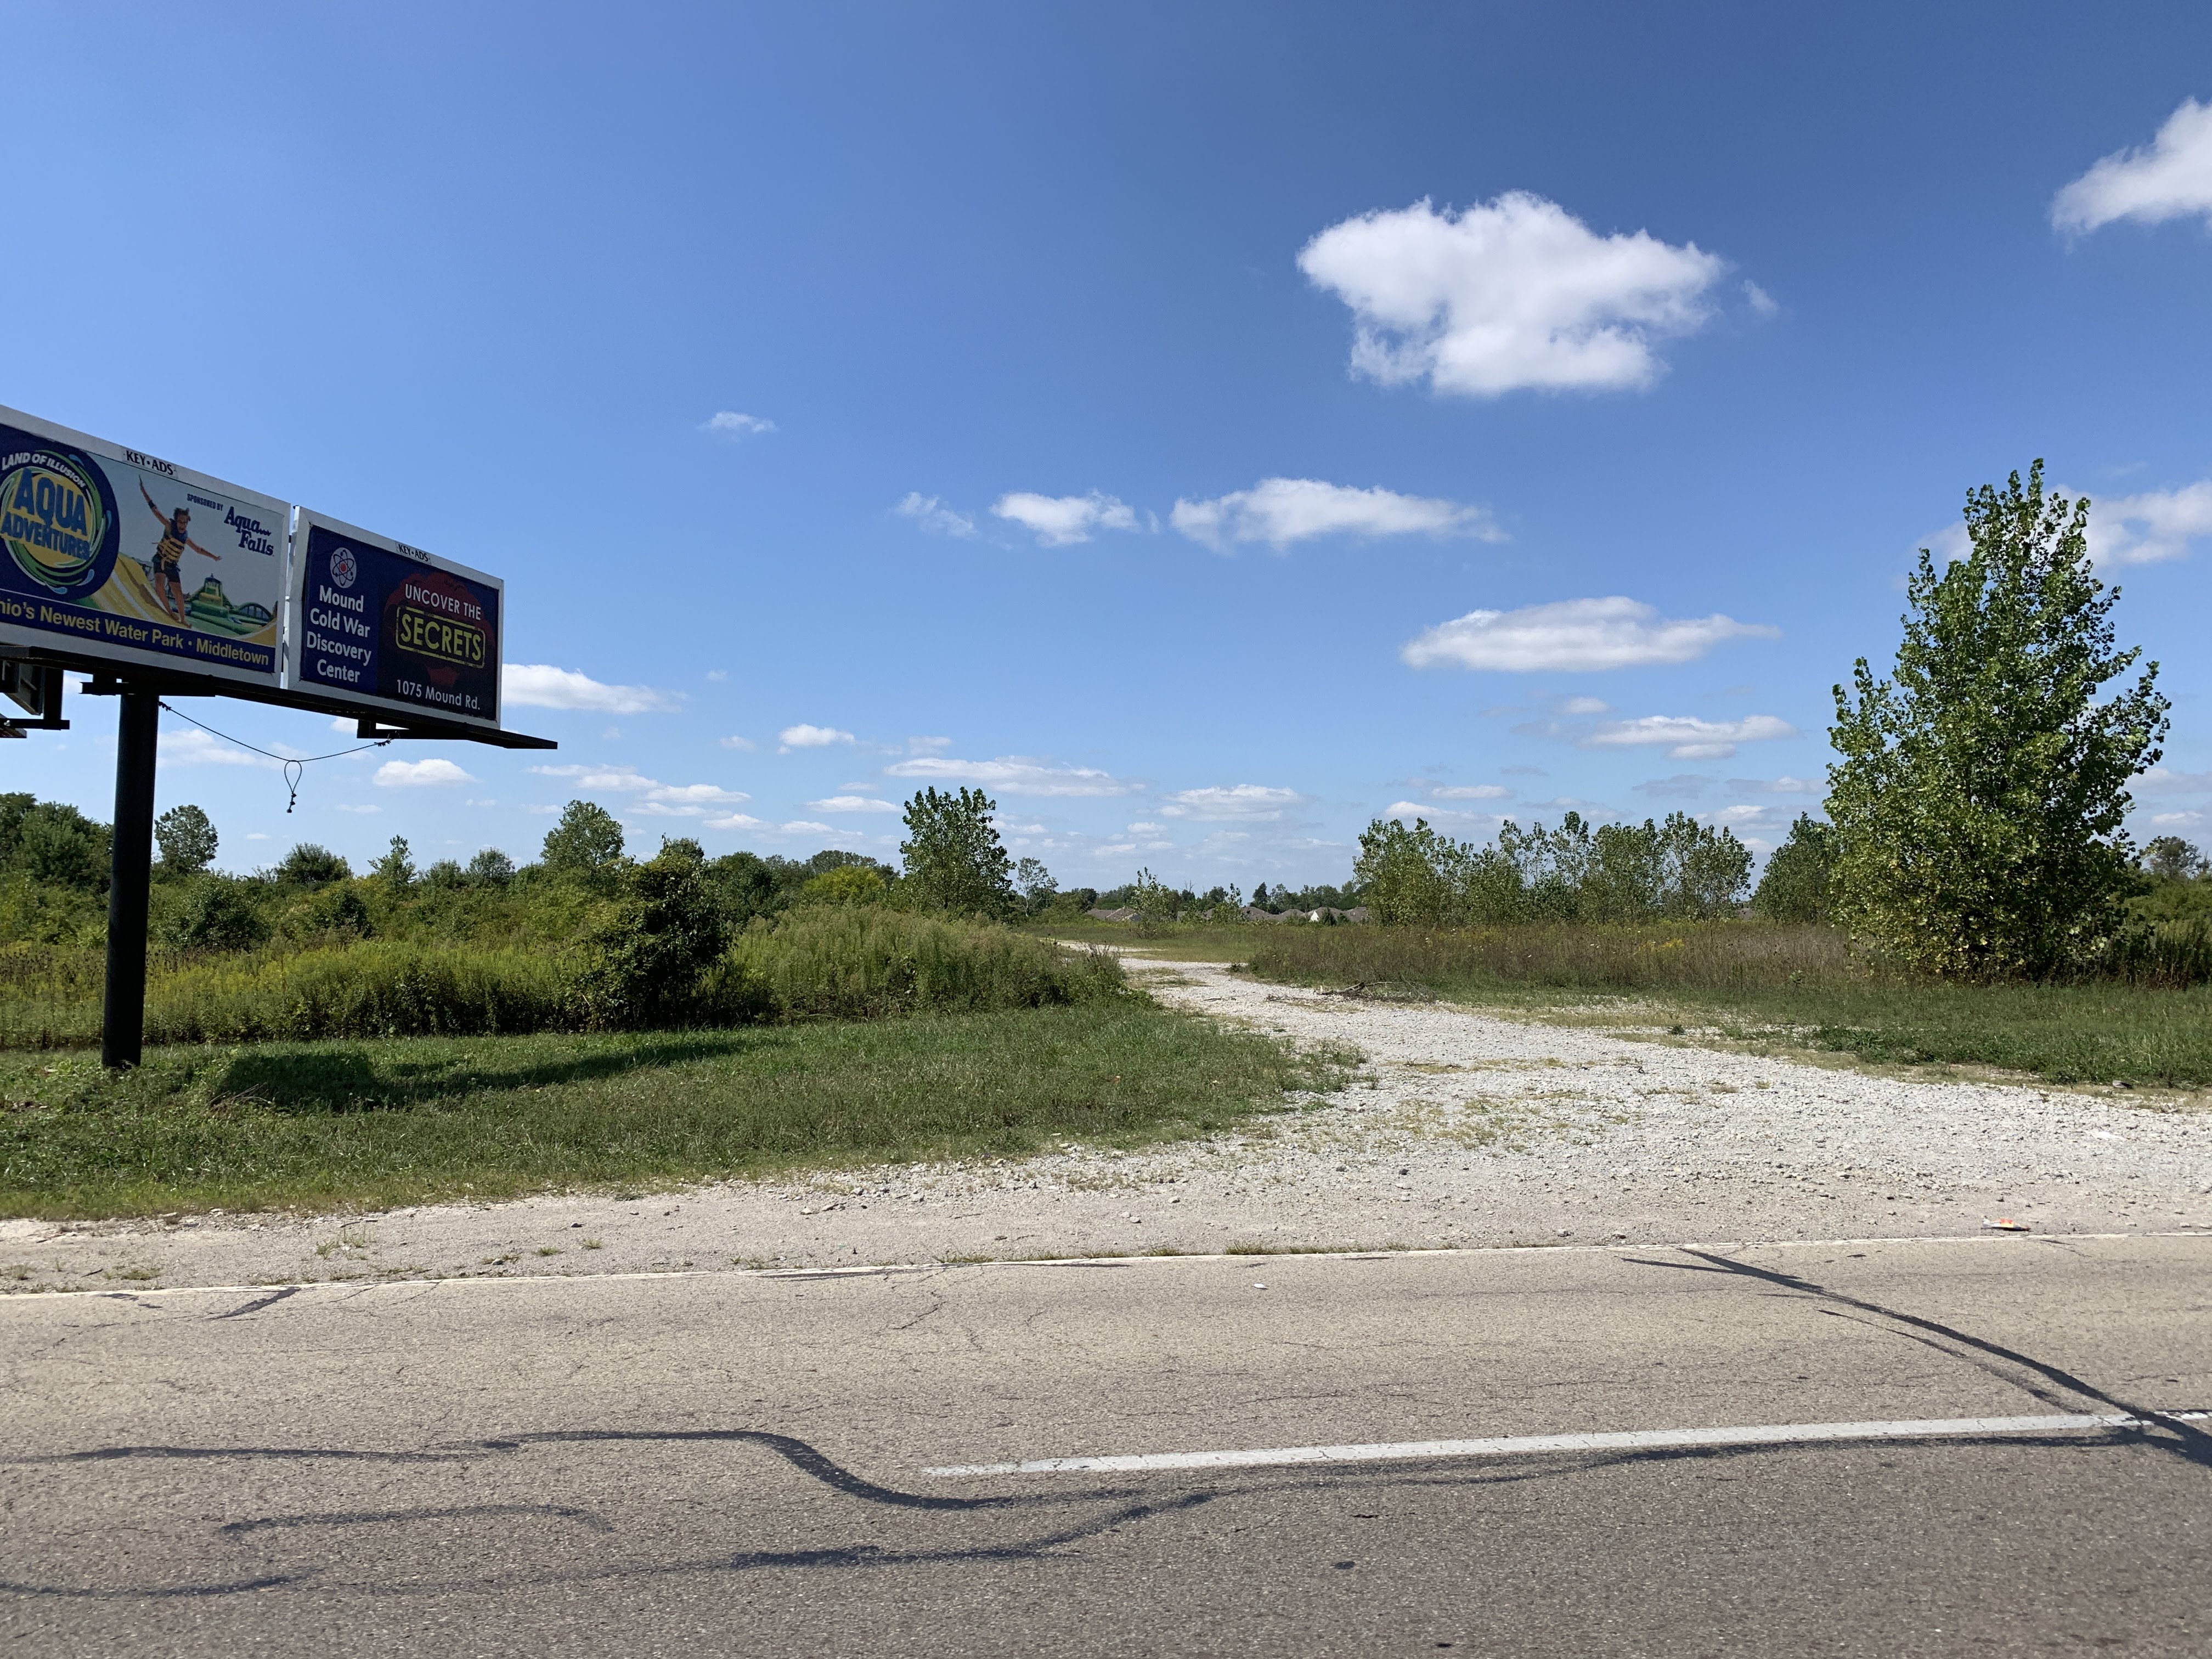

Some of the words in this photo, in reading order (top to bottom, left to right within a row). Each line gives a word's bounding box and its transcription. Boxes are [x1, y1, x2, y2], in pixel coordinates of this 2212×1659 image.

[2, 452, 31, 470] LAND
[32, 454, 48, 464] OF
[47, 456, 87, 487] ILLUSION
[13, 466, 88, 537] AQUA
[187, 493, 216, 509] SPONSORED
[1, 510, 91, 560] ADVENTURES
[224, 506, 261, 534] Aqua
[238, 529, 274, 556] Falls
[319, 584, 364, 613] Mound
[405, 584, 460, 613] UNCOVER
[464, 602, 481, 620] THE
[40, 605, 100, 632] Newest
[105, 619, 148, 641] Water
[152, 629, 183, 648] Park
[196, 638, 269, 665] Middletown
[310, 608, 340, 630] Cold
[343, 616, 370, 637] War
[400, 613, 482, 661] SECRETS
[307, 631, 372, 666] Discovery
[317, 659, 360, 683] Center
[397, 679, 422, 698] 1075
[425, 686, 461, 706] Mound
[465, 695, 481, 710] Rd.
